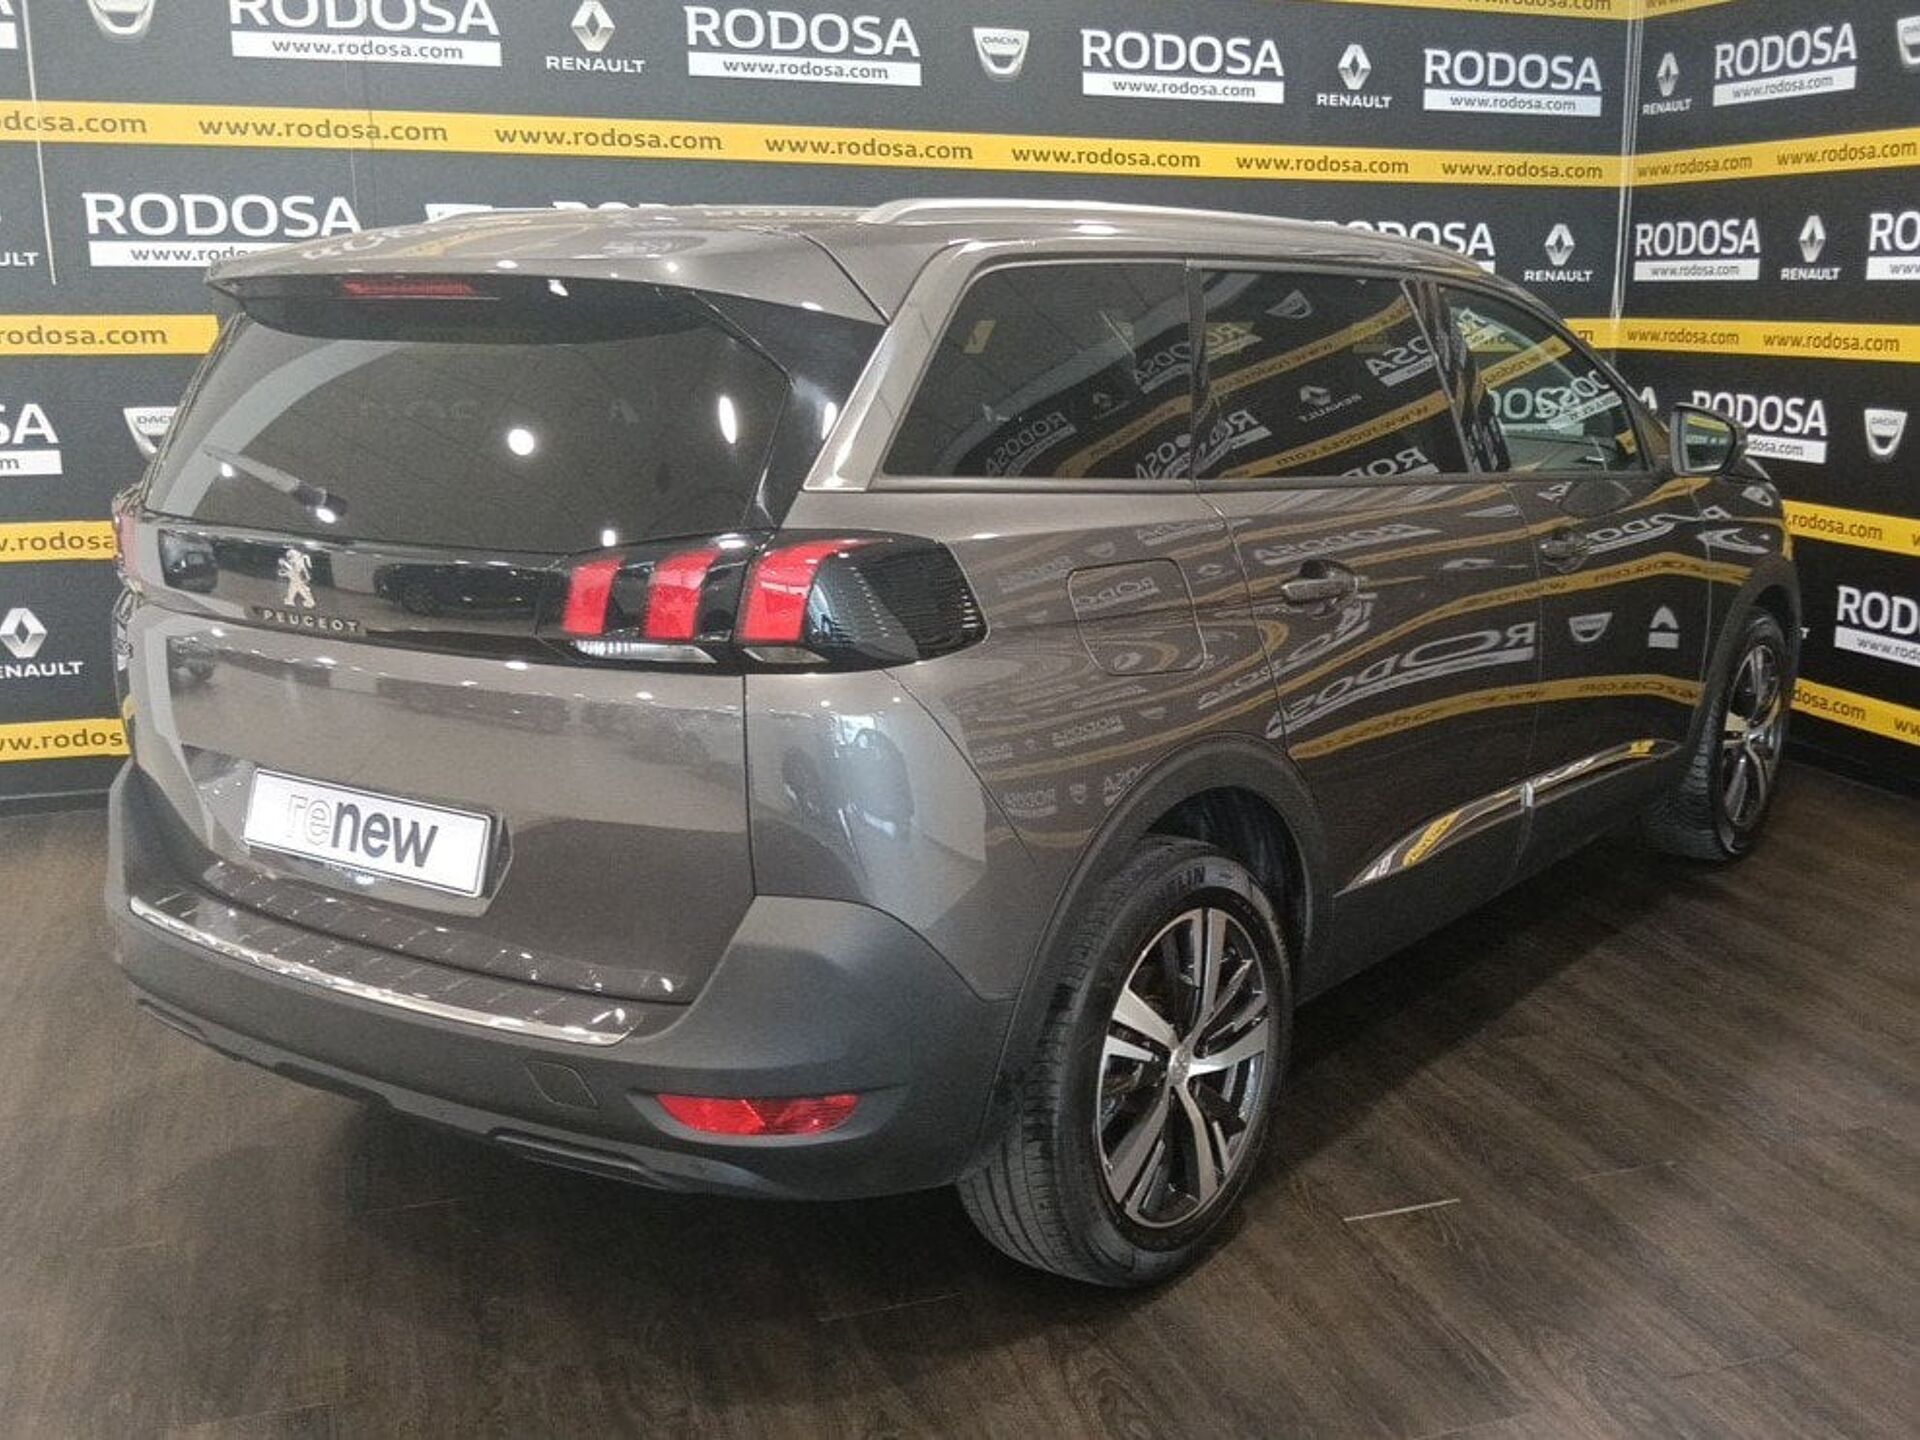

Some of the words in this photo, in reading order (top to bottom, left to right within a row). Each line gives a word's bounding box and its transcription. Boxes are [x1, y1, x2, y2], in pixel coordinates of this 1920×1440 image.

[684, 5, 920, 57] RODOSA
[271, 36, 465, 61] www.rodosa.com
[1081, 29, 1285, 77] RODOSA
[1714, 22, 1858, 81] RODOSA
[545, 55, 646, 73] RENAULT
[722, 57, 889, 81] www.rodosa.com
[1424, 48, 1603, 92] RODOSA
[1112, 78, 1257, 98] www.rodosa.com
[1732, 75, 1835, 99] www.rodosa.com
[1316, 93, 1393, 109] RENAULT
[1450, 93, 1577, 112] www.rodosa.com
[1642, 98, 1693, 116] RENAULT
[0, 110, 147, 134] dosa.com
[198, 115, 449, 143] www.rodosa.com
[494, 124, 722, 153] www.rodosa.com
[764, 134, 974, 161] www.rodosa.com
[1011, 144, 1202, 169] www.rodosa.com
[1236, 154, 1410, 176] www.rodosa.com
[1636, 154, 1753, 178] www.rodosa.com
[1776, 140, 1918, 168] www.rodosa.com
[1441, 160, 1603, 181] www.rodosa.com
[82, 191, 362, 237] RODOSA
[1635, 218, 1761, 257] RODOSA
[1524, 269, 1593, 283] RENAULT
[1650, 264, 1740, 277] www.rodosa.com
[1781, 267, 1842, 281] RENAULT
[1626, 329, 1740, 346] www.rodosa.com
[1762, 332, 1900, 352] www.rodosa.com
[1785, 512, 1883, 541] .rodosa.com
[263, 609, 357, 632] PEUGEOT
